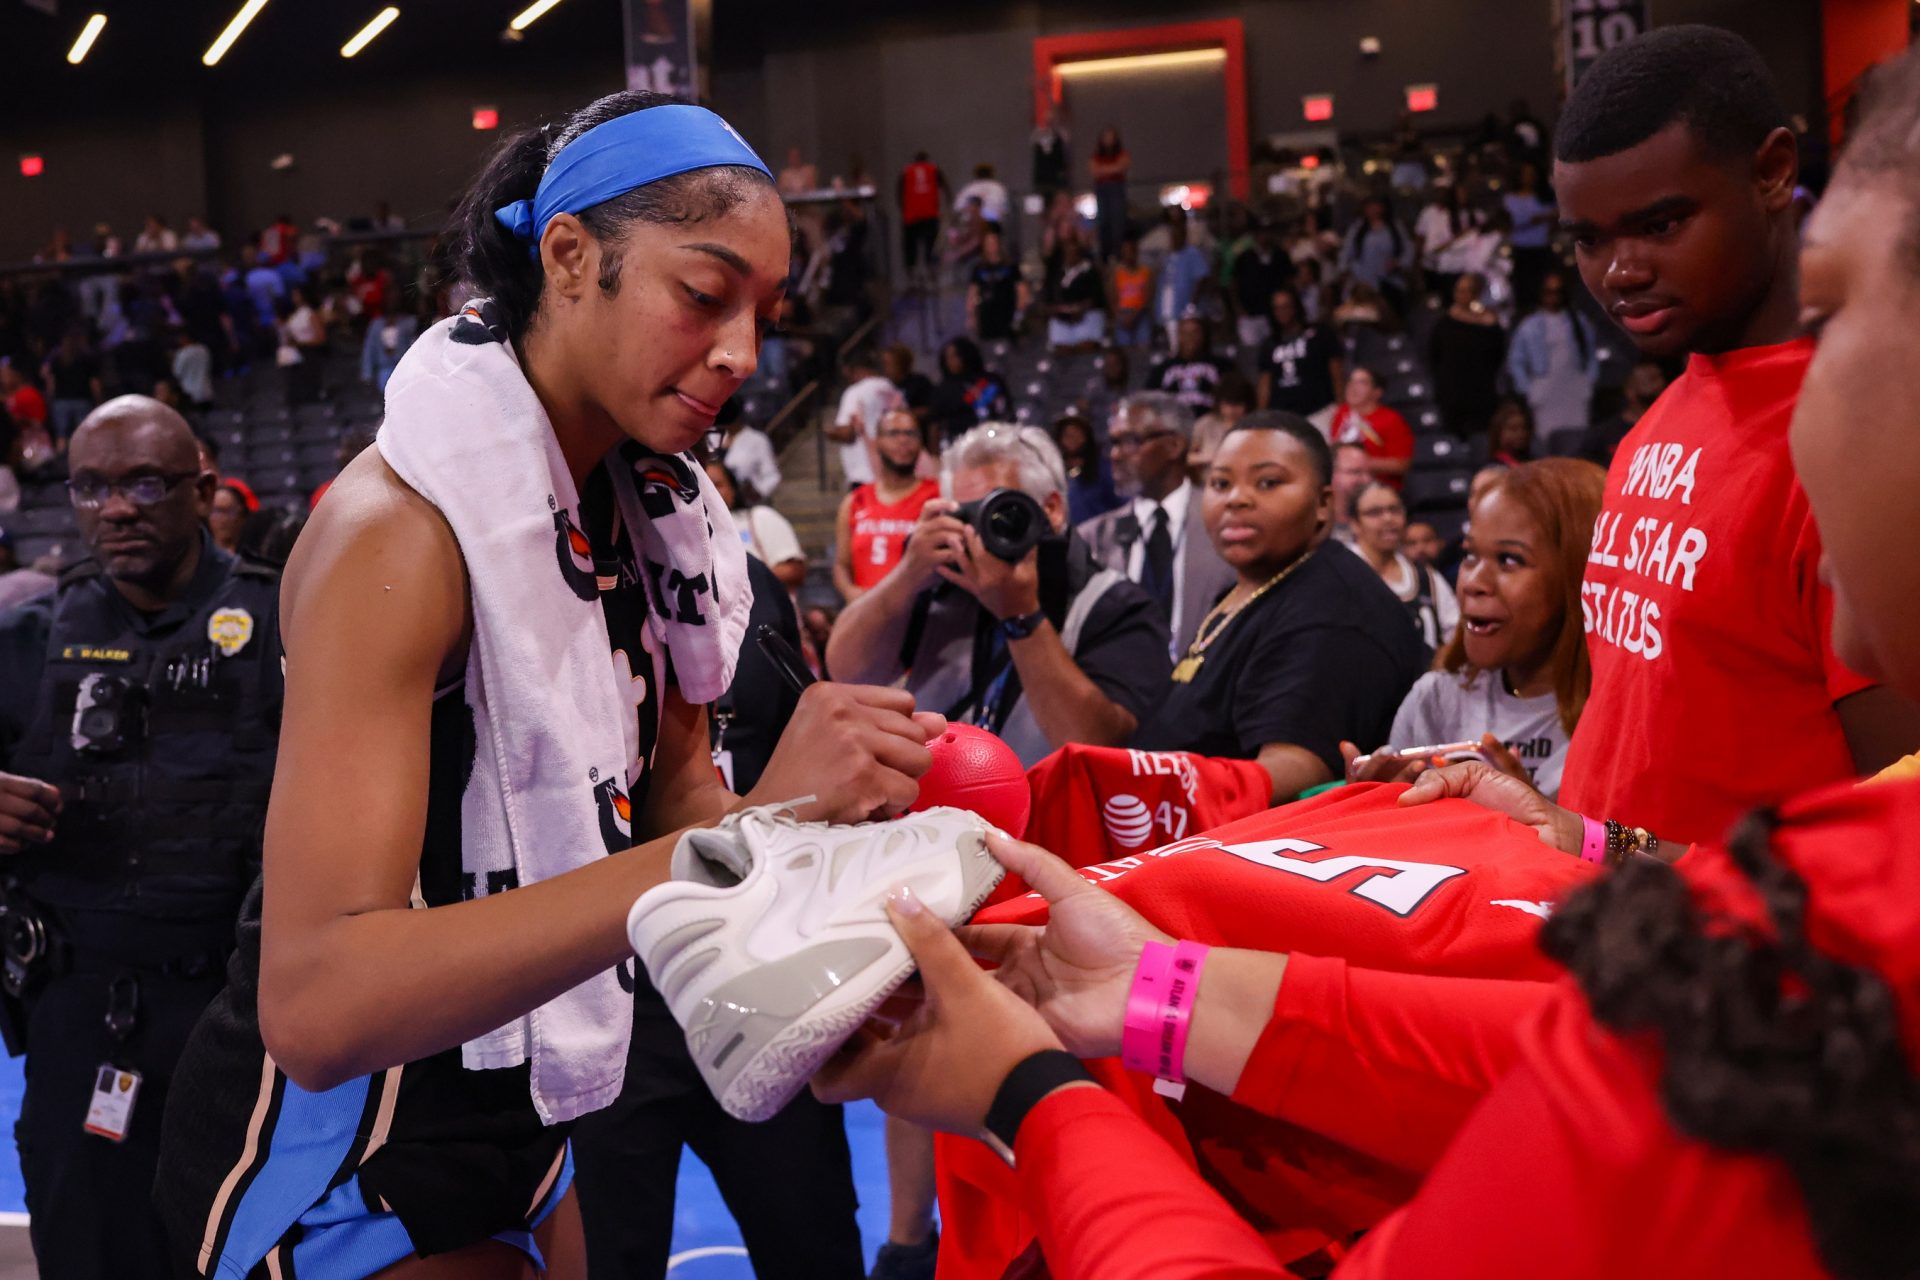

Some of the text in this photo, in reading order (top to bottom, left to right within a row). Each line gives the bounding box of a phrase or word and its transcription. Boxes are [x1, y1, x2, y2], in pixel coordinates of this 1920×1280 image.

[1621, 442, 1703, 505] WNBA
[1588, 511, 1708, 591] LL STAR
